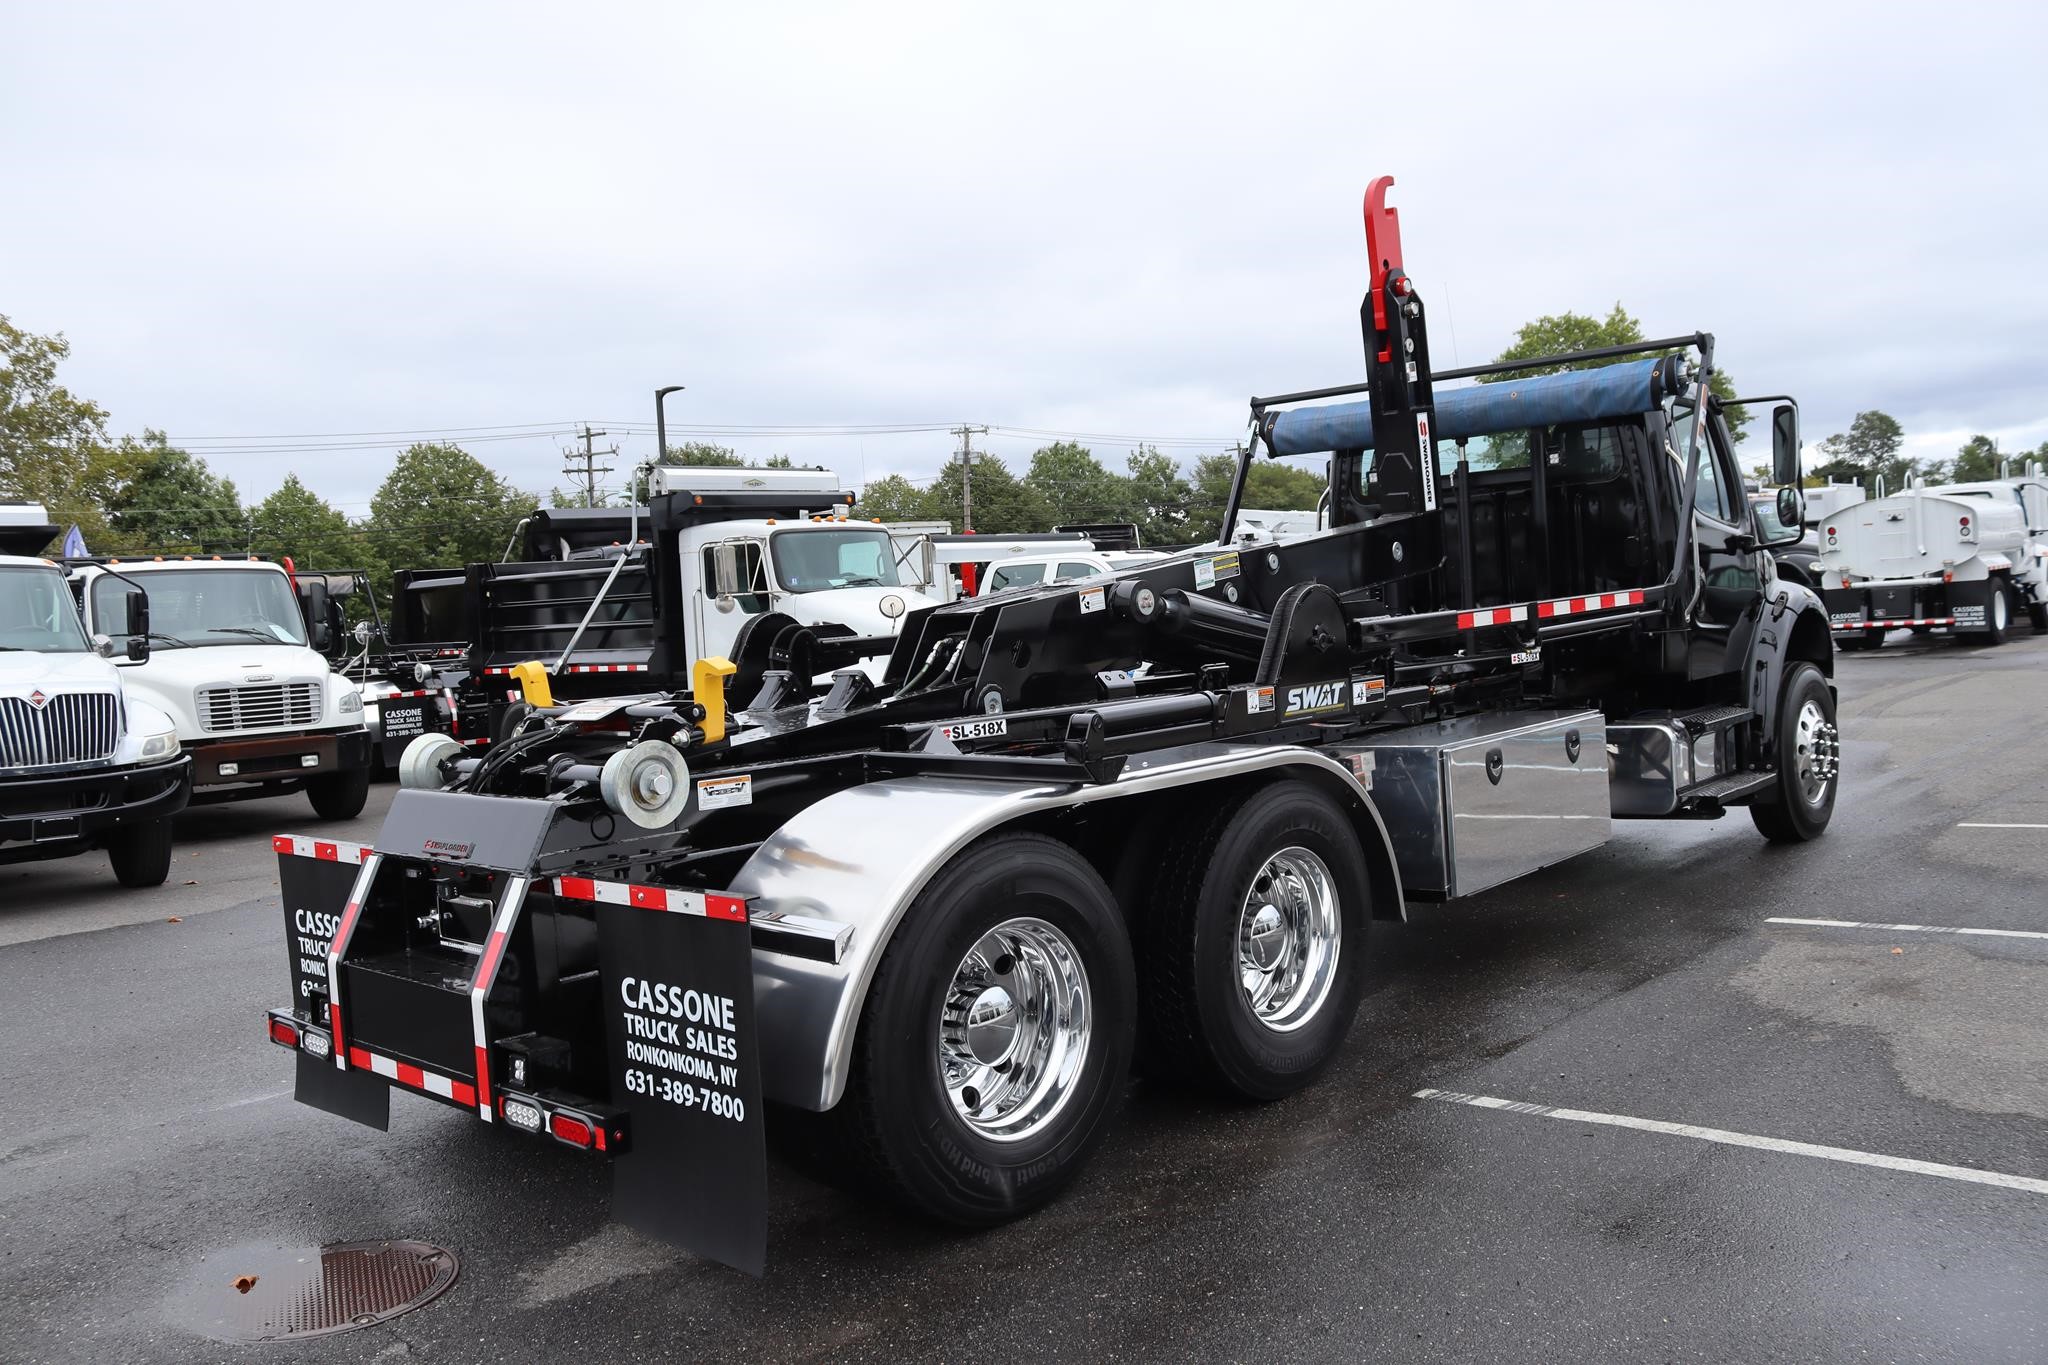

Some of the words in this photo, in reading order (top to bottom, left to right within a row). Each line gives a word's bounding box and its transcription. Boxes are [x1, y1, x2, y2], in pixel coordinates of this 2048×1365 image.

[1422, 439, 1433, 503] SWAPLOADER
[385, 708, 422, 718] CASSONE
[1286, 681, 1345, 713] SWAT
[295, 908, 340, 938] CASSO
[621, 977, 736, 1032] CASSONE
[623, 1012, 681, 1046] TRUCK
[685, 1027, 738, 1061] SALES
[626, 1040, 719, 1085] RONKONKOMA,
[720, 1064, 738, 1088] NY
[625, 1068, 745, 1122] 631-389-7800
